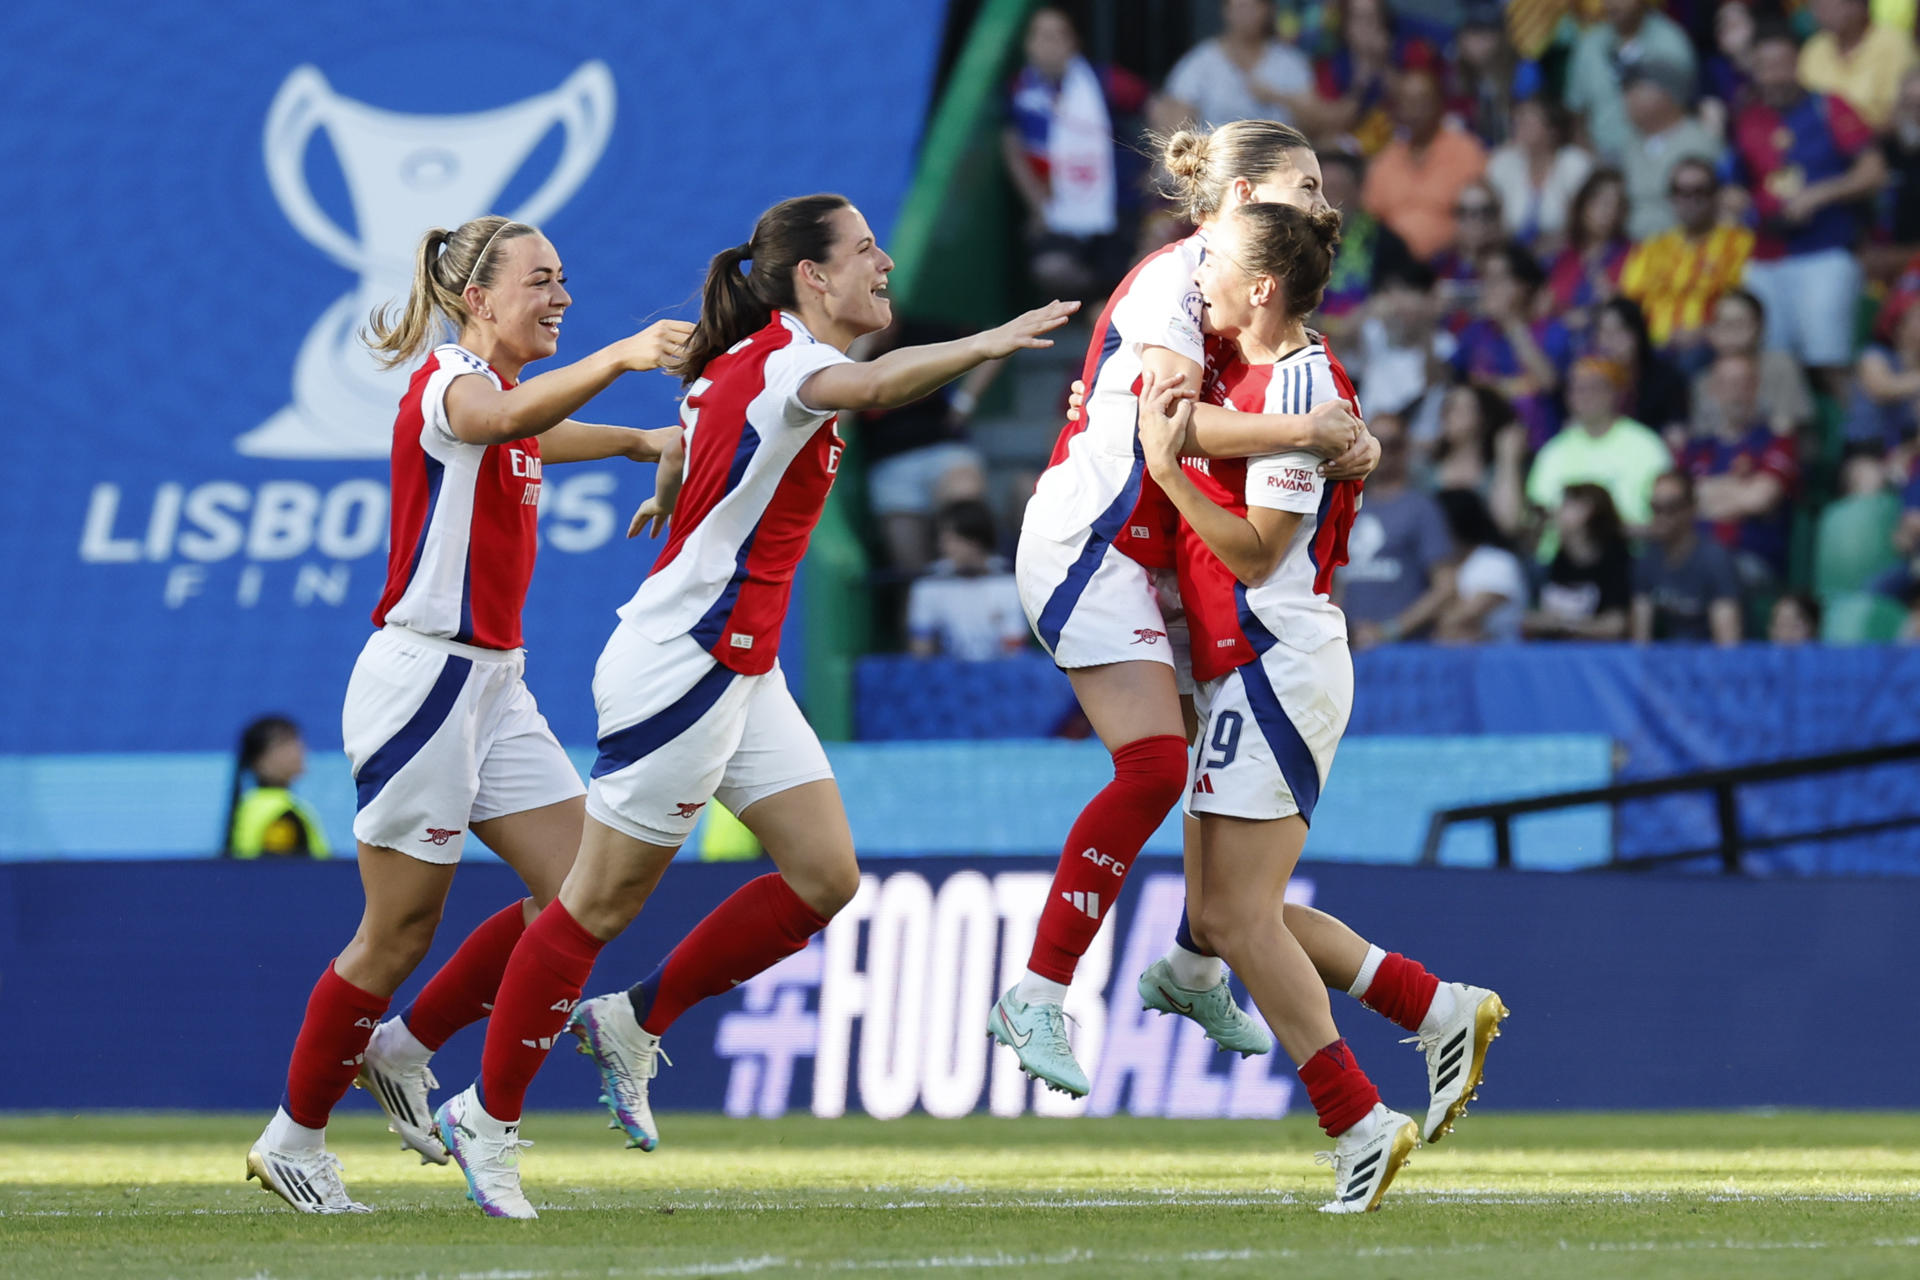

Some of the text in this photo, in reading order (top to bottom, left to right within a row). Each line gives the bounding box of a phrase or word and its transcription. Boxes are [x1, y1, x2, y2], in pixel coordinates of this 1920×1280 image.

[1267, 475, 1315, 494] RWAND
[1284, 468, 1313, 481] VISIT
[79, 478, 391, 562] LISBO
[164, 563, 385, 609] FIN
[1082, 847, 1125, 877] AFC
[550, 998, 580, 1013] AF
